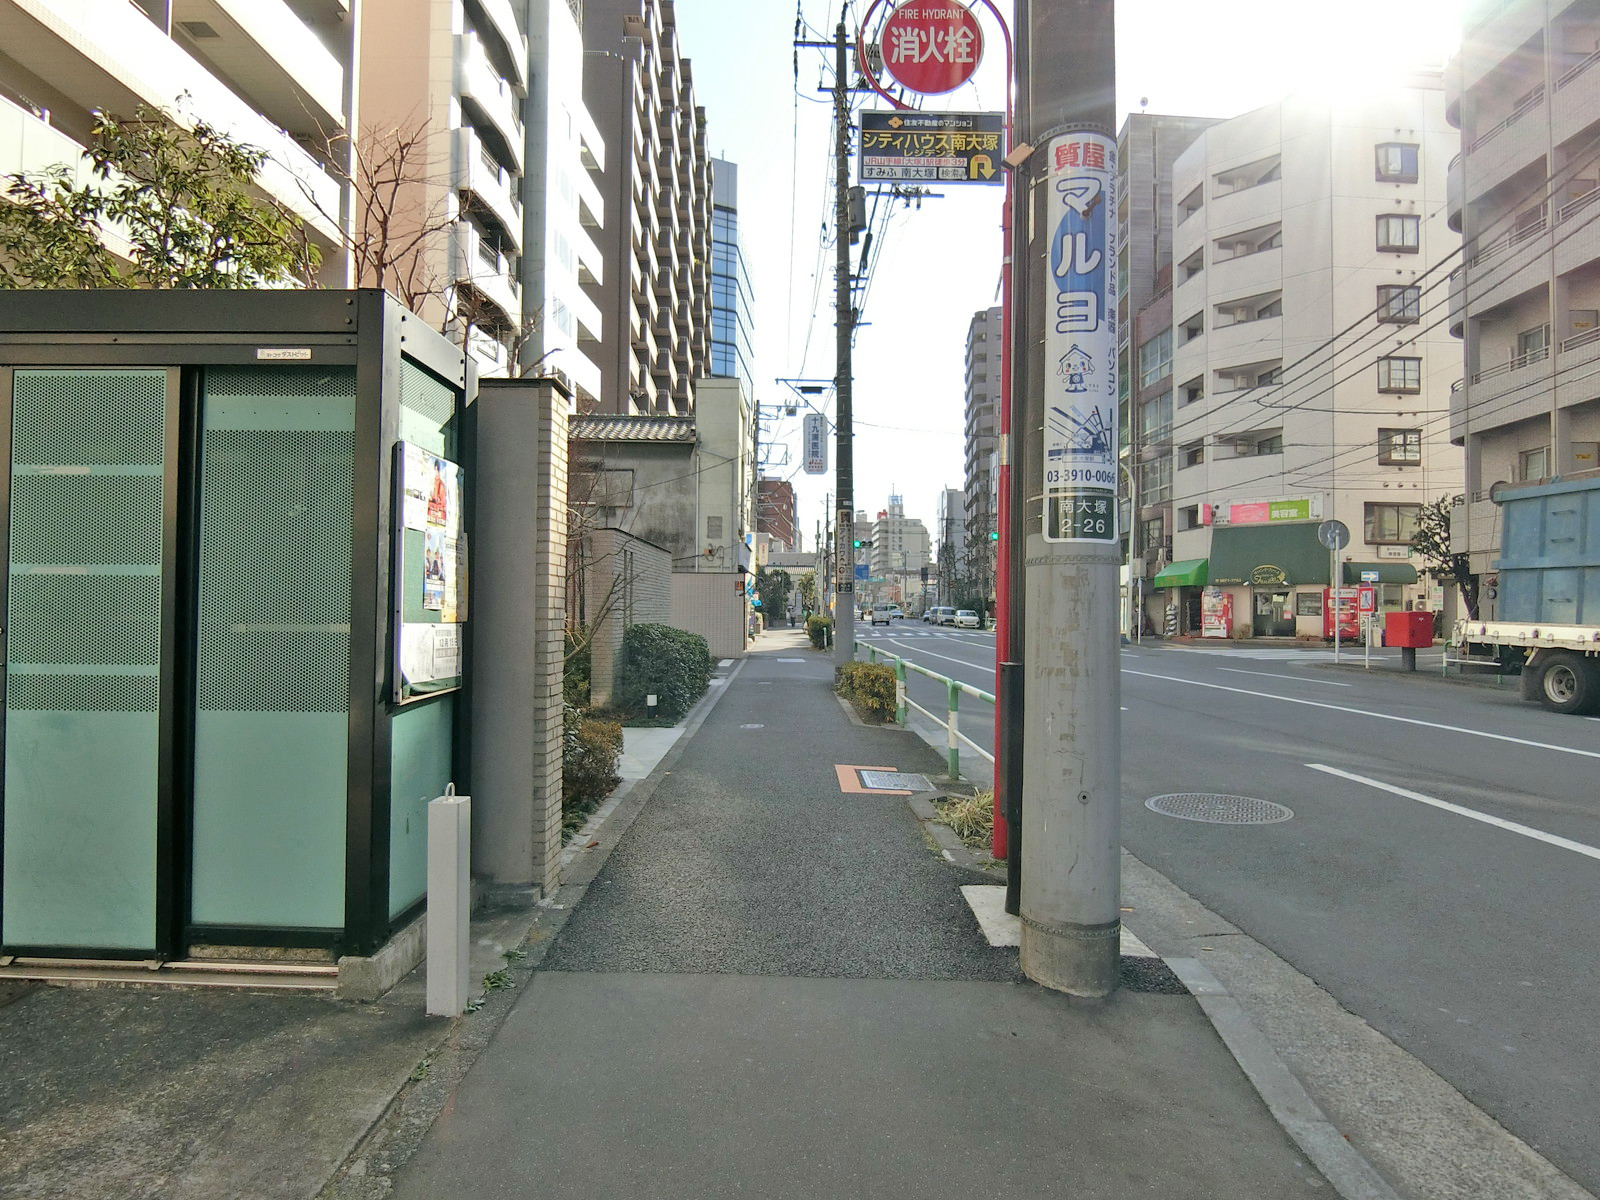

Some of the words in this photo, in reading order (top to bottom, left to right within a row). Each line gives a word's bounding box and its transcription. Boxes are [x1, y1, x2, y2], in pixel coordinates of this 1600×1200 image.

[899, 9, 919, 19] FIRE
[922, 9, 965, 19] HYDRANT
[891, 26, 975, 63] 消火栓
[903, 118, 973, 127] 住友不動産のマンション
[863, 133, 998, 151] シティハウス南大塚
[903, 149, 957, 158] レジデンス
[1055, 142, 1105, 171] 質屋
[866, 167, 897, 177] すみふ
[901, 167, 934, 178] 南大塚
[941, 168, 960, 178] 検索
[1108, 233, 1117, 296] ブランド品
[1107, 347, 1116, 396] パソコン
[1047, 469, 1116, 484] 03-3910-0066
[1060, 499, 1107, 514] 南大塚
[1061, 518, 1105, 533] 2-26
